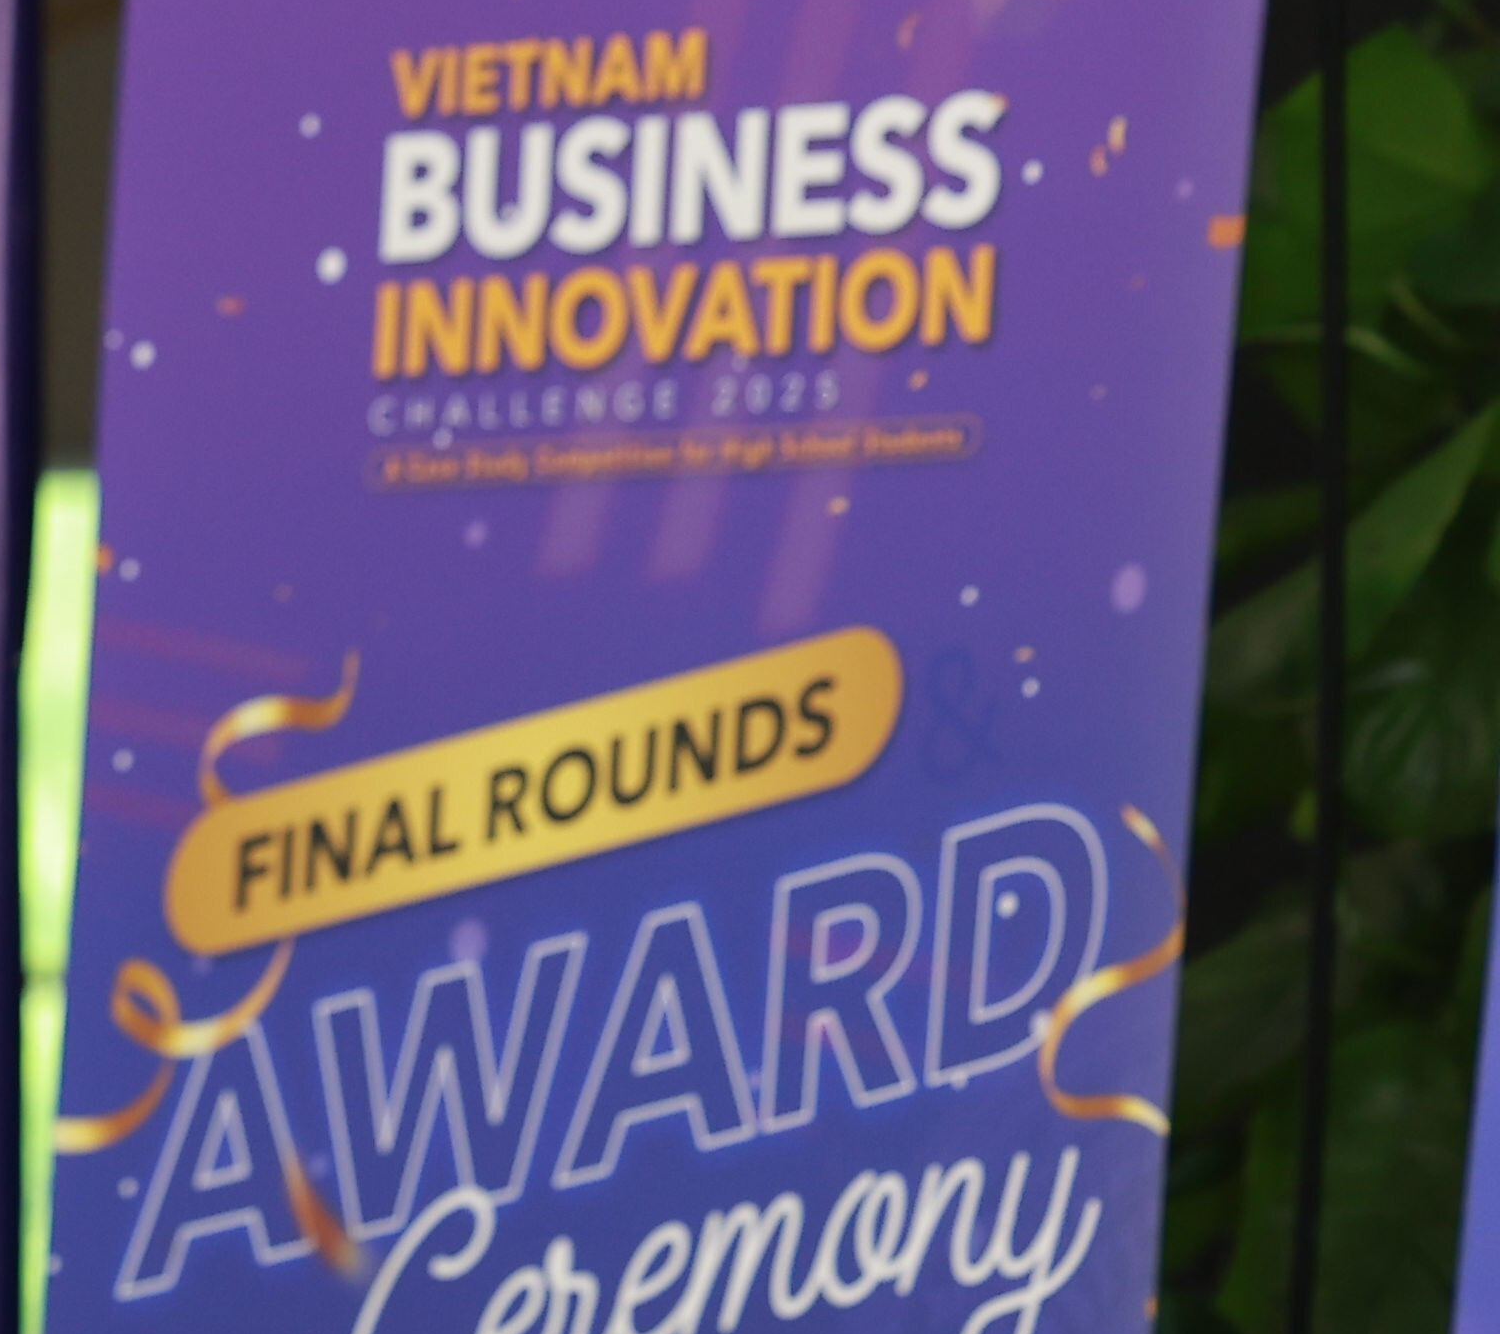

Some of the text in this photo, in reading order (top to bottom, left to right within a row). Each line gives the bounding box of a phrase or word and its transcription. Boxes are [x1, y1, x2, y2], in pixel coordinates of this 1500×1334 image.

[391, 28, 706, 117] VIETNAM
[377, 90, 1003, 264] BUSINESS
[370, 243, 998, 379] INNOVATION
[366, 369, 840, 438] CHALLENGE 2025
[231, 674, 841, 914] FINAL ROUNDS
[114, 801, 1111, 1300] AWARD
